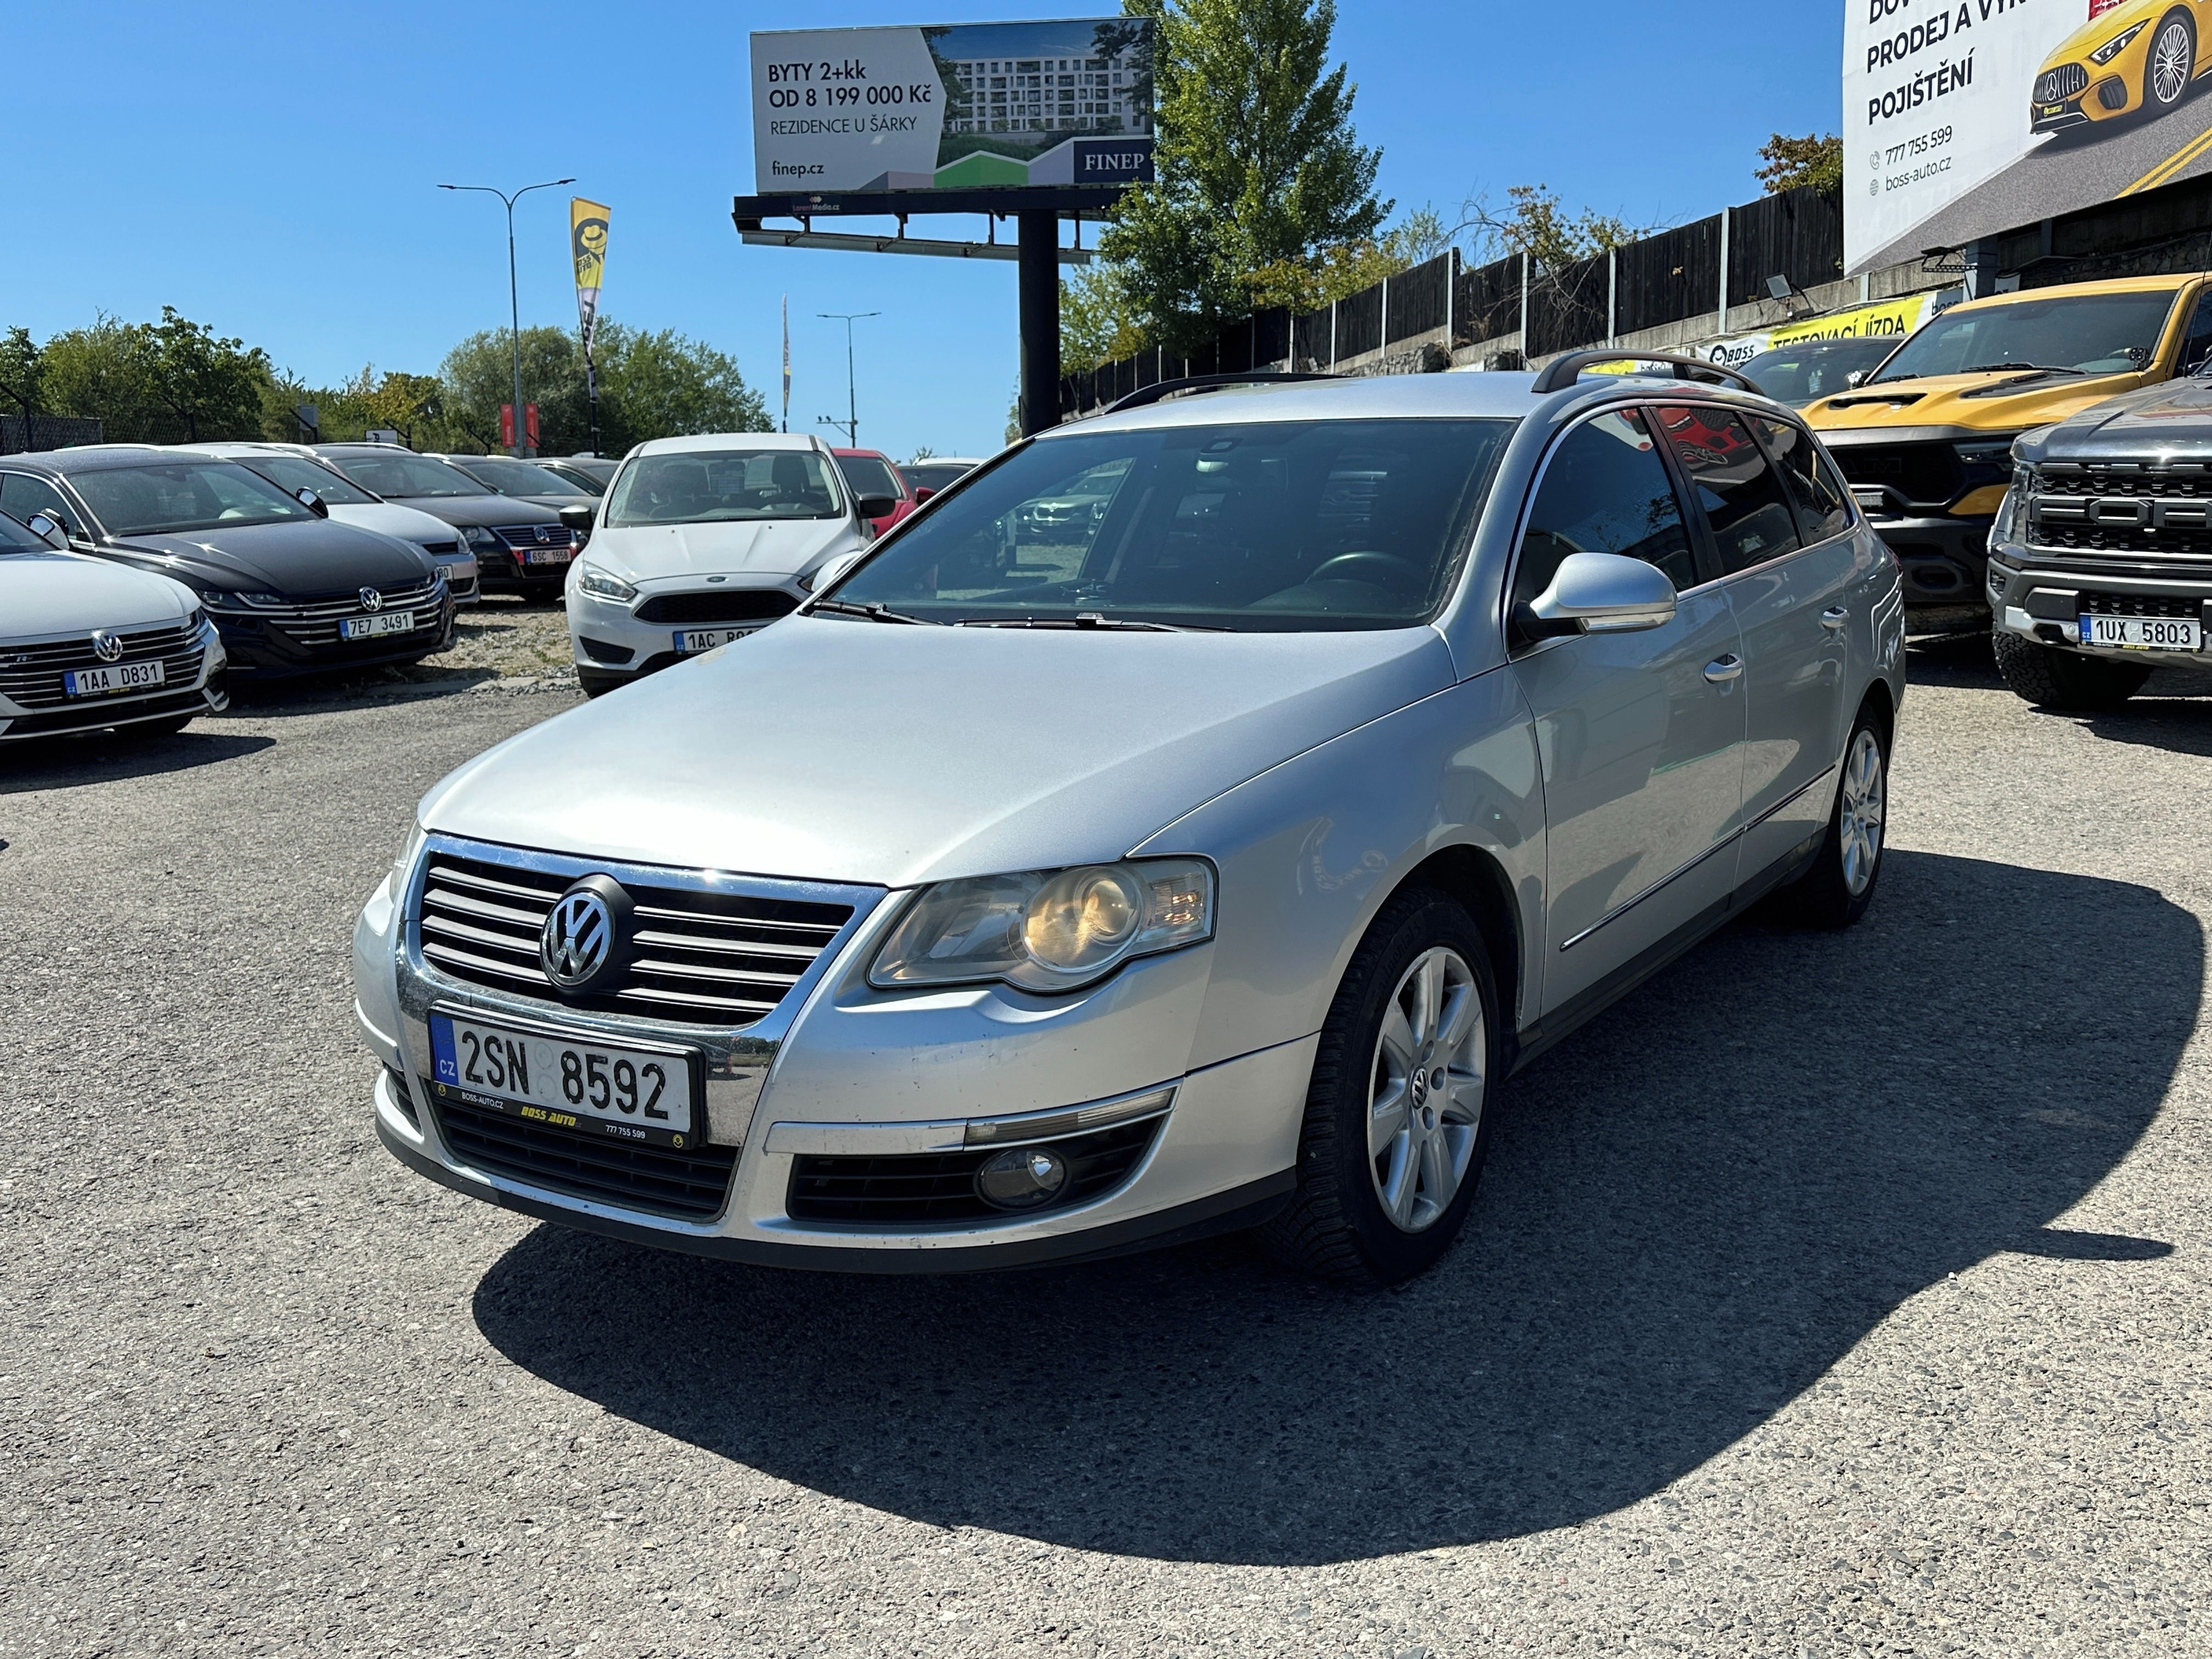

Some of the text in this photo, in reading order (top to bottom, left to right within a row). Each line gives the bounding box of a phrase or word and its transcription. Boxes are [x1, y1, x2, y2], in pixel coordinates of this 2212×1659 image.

[1867, 10, 1949, 74] PRODEJ
[1954, 2, 1972, 33] A
[769, 59, 866, 82] BYTY 2+kk
[769, 84, 931, 108] OD 8 199 000 Kč
[1869, 47, 1975, 126] POJIŠTĚNÍ
[771, 114, 917, 135] REZIDENCE U ŠÁRKY
[1886, 125, 1952, 165] 777 755 599
[772, 160, 824, 178] finep.cz
[1085, 154, 1144, 170] FINEP
[1886, 157, 1951, 191] boss-auto.cz
[1727, 344, 1754, 363] BOSS
[532, 551, 568, 561] 6SC 1558
[350, 614, 408, 635] 7E7 3491
[2096, 620, 2190, 644] 1UX 5803
[689, 633, 715, 648] 1AC
[81, 664, 157, 690] 1AA D831
[440, 1059, 455, 1076] CZ
[462, 1031, 669, 1120] 2SN 8592
[461, 1092, 504, 1109] BOSS-AUTO.CZ
[521, 1106, 547, 1120] BOSS
[548, 1112, 577, 1127] AUTO
[606, 1125, 646, 1139] 777 755 599
